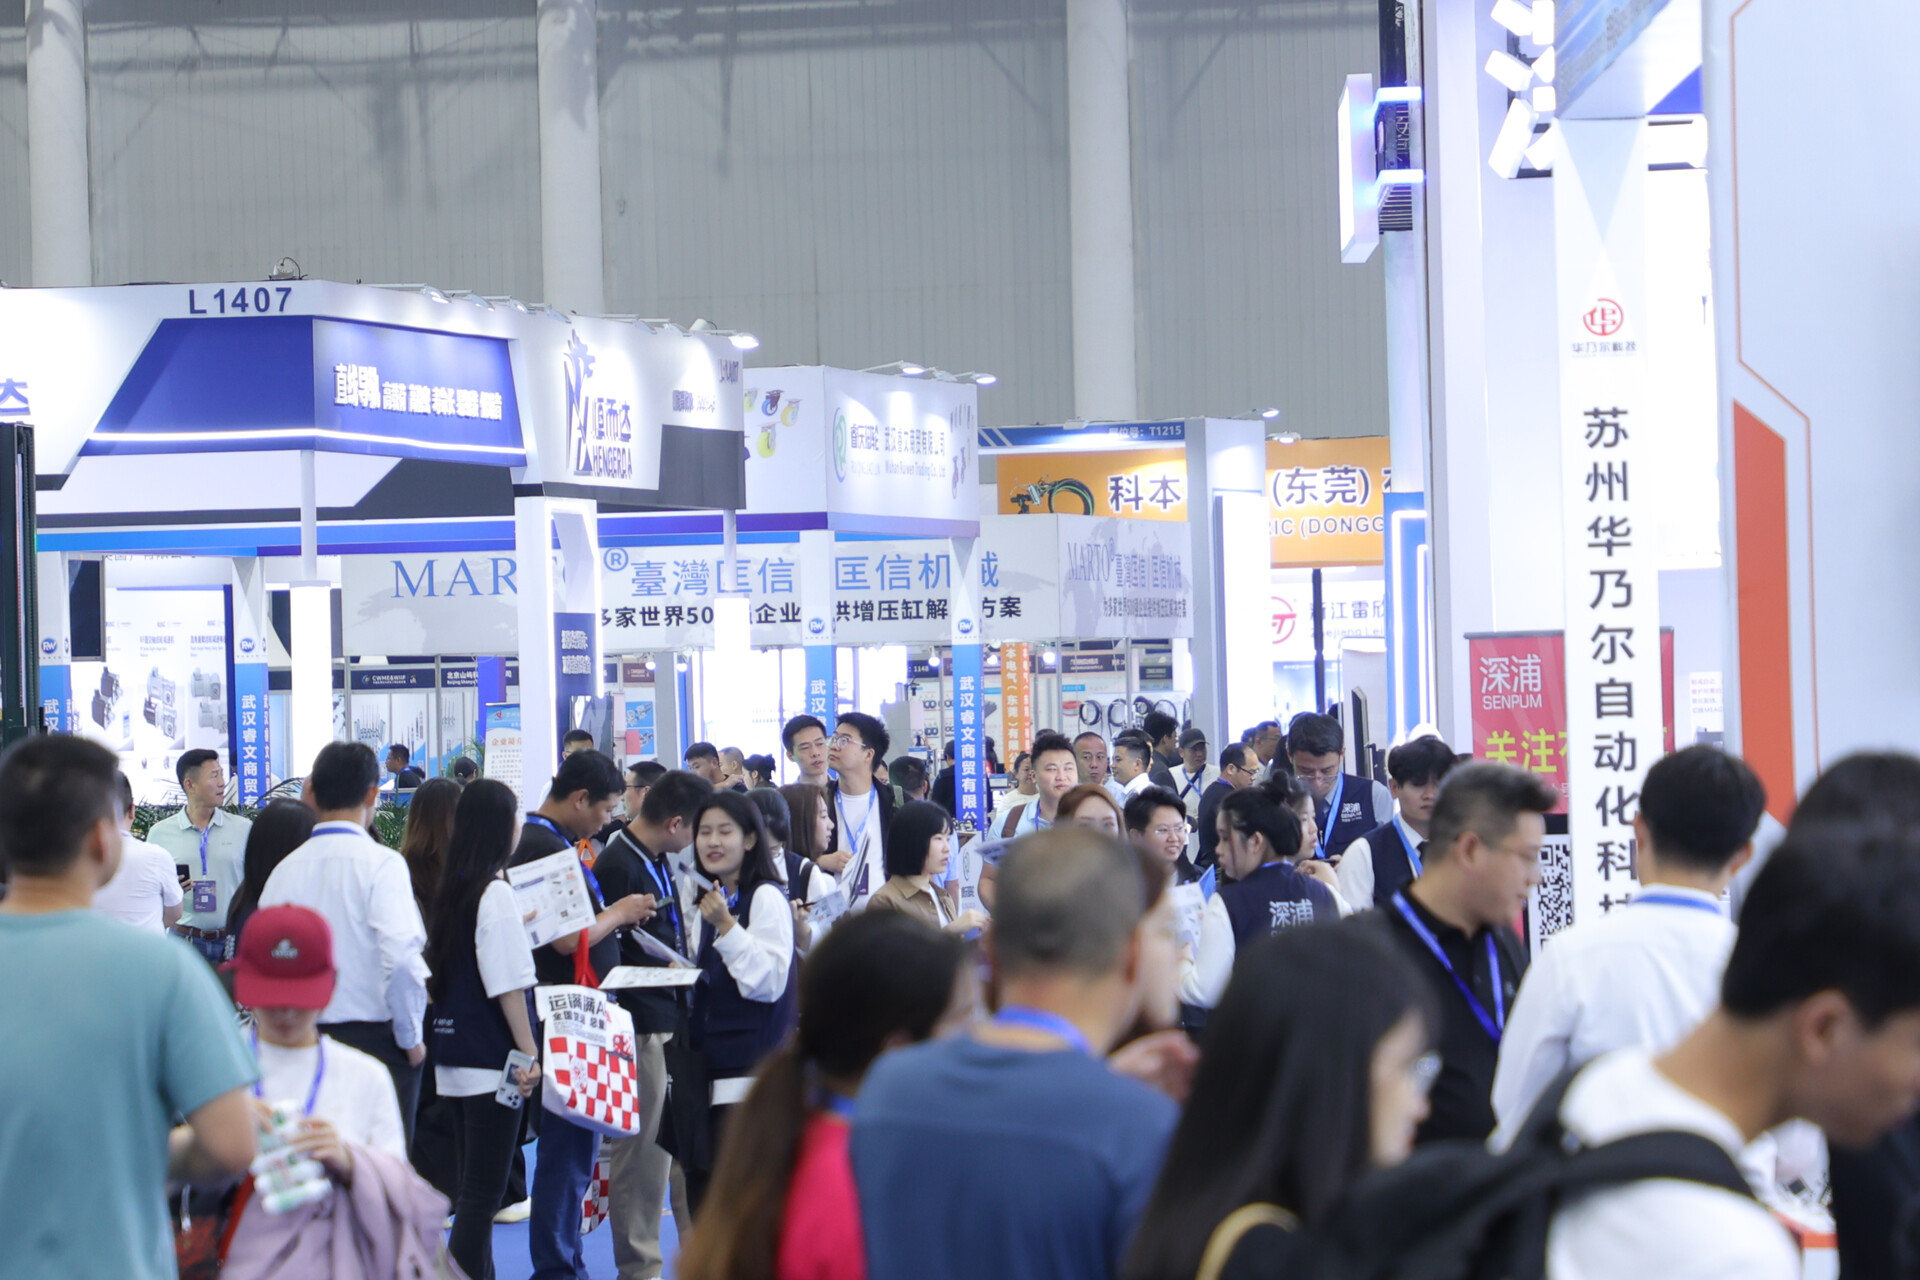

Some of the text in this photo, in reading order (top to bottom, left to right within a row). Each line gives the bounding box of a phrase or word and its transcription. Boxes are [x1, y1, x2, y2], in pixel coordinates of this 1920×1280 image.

[189, 287, 292, 314] L1407
[1149, 426, 1182, 437] T1215
[592, 445, 633, 479] HENGERDA
[1110, 475, 1181, 511] 科本
[1480, 653, 1542, 694] 深浦
[1482, 693, 1543, 711] SENPUM
[1269, 898, 1315, 928] 深浦
